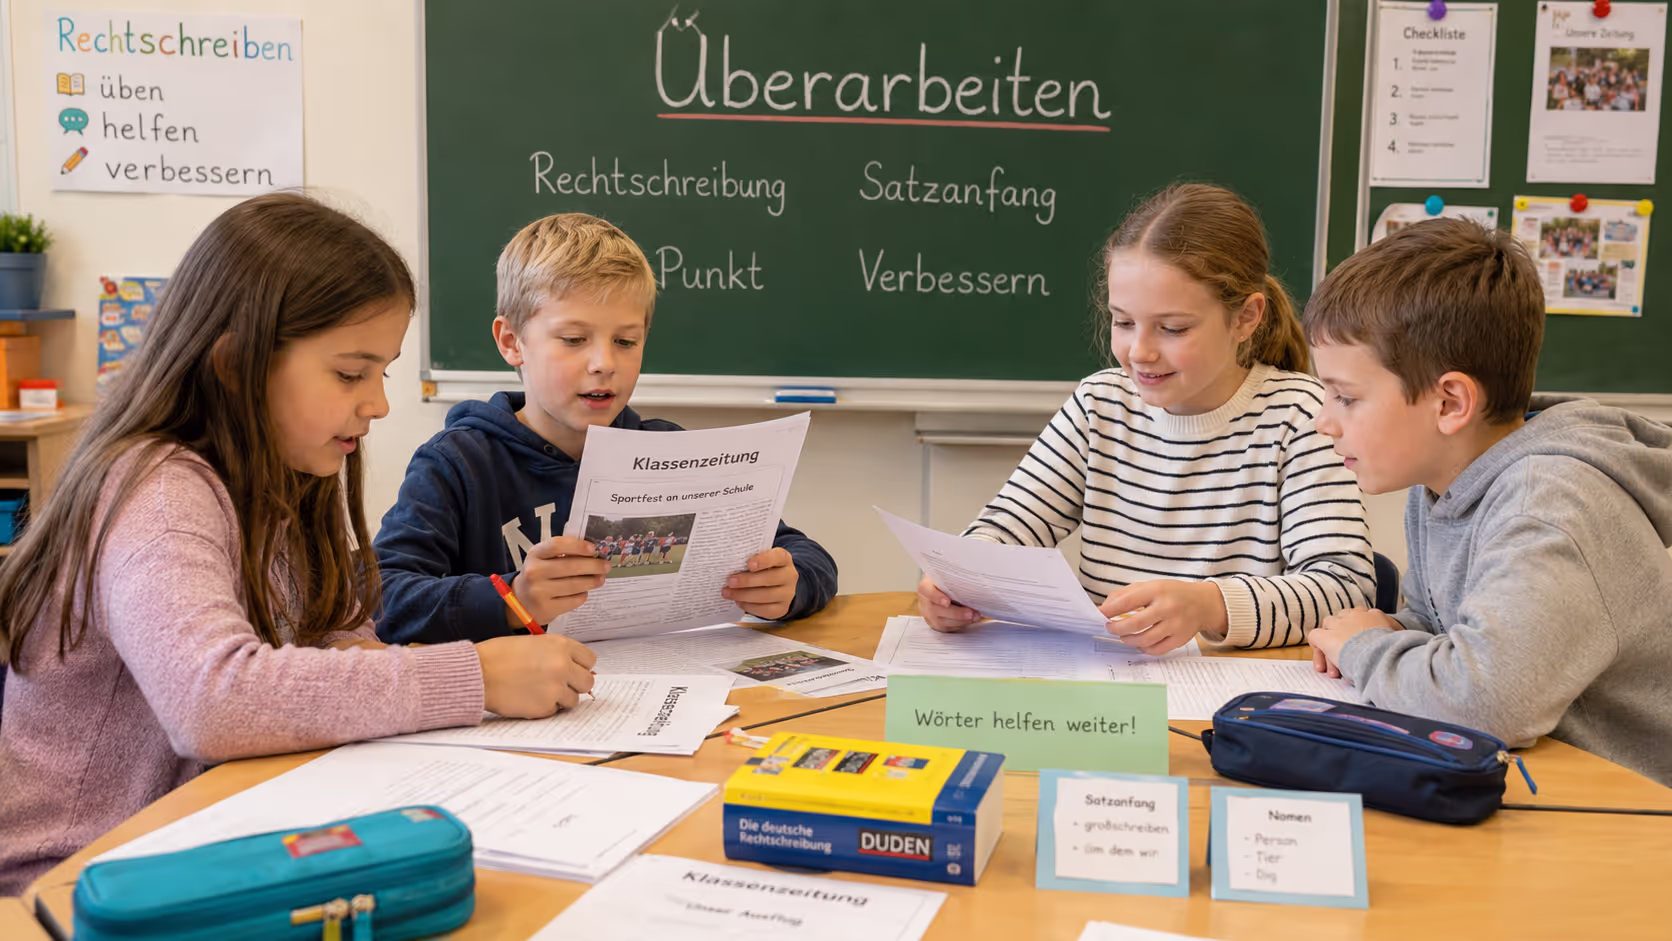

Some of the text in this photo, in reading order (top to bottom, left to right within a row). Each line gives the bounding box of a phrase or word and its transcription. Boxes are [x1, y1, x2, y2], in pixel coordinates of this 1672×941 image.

[57, 17, 293, 62] Rechtschreiben
[1403, 27, 1466, 41] Checkliste
[655, 12, 1112, 119] Überarbeiten
[1393, 57, 1403, 71] 1.
[100, 75, 164, 102] üben
[1391, 85, 1402, 98] 2.
[103, 112, 199, 143] helfen
[1389, 112, 1400, 126] 3.
[1387, 140, 1400, 153] 4.
[105, 155, 274, 186] verbessern
[529, 151, 787, 217] Rechtschreibung
[858, 160, 1057, 225] Satzanfang
[656, 245, 765, 291] Punkt
[858, 248, 1051, 297] Verbessern
[632, 450, 760, 471] Klassenzeitung
[610, 483, 754, 504] Sportfest an unserer Schule
[915, 708, 1137, 735] Wörter helfen weiter!
[1084, 794, 1156, 812] Satzanfang
[739, 818, 814, 838] Die deutsche
[1268, 810, 1312, 823] Nomen
[739, 831, 833, 855] Rechtschreibung
[861, 832, 931, 857] DUDEN
[1257, 850, 1282, 863] Tier
[682, 869, 869, 907] Klassenzeitung
